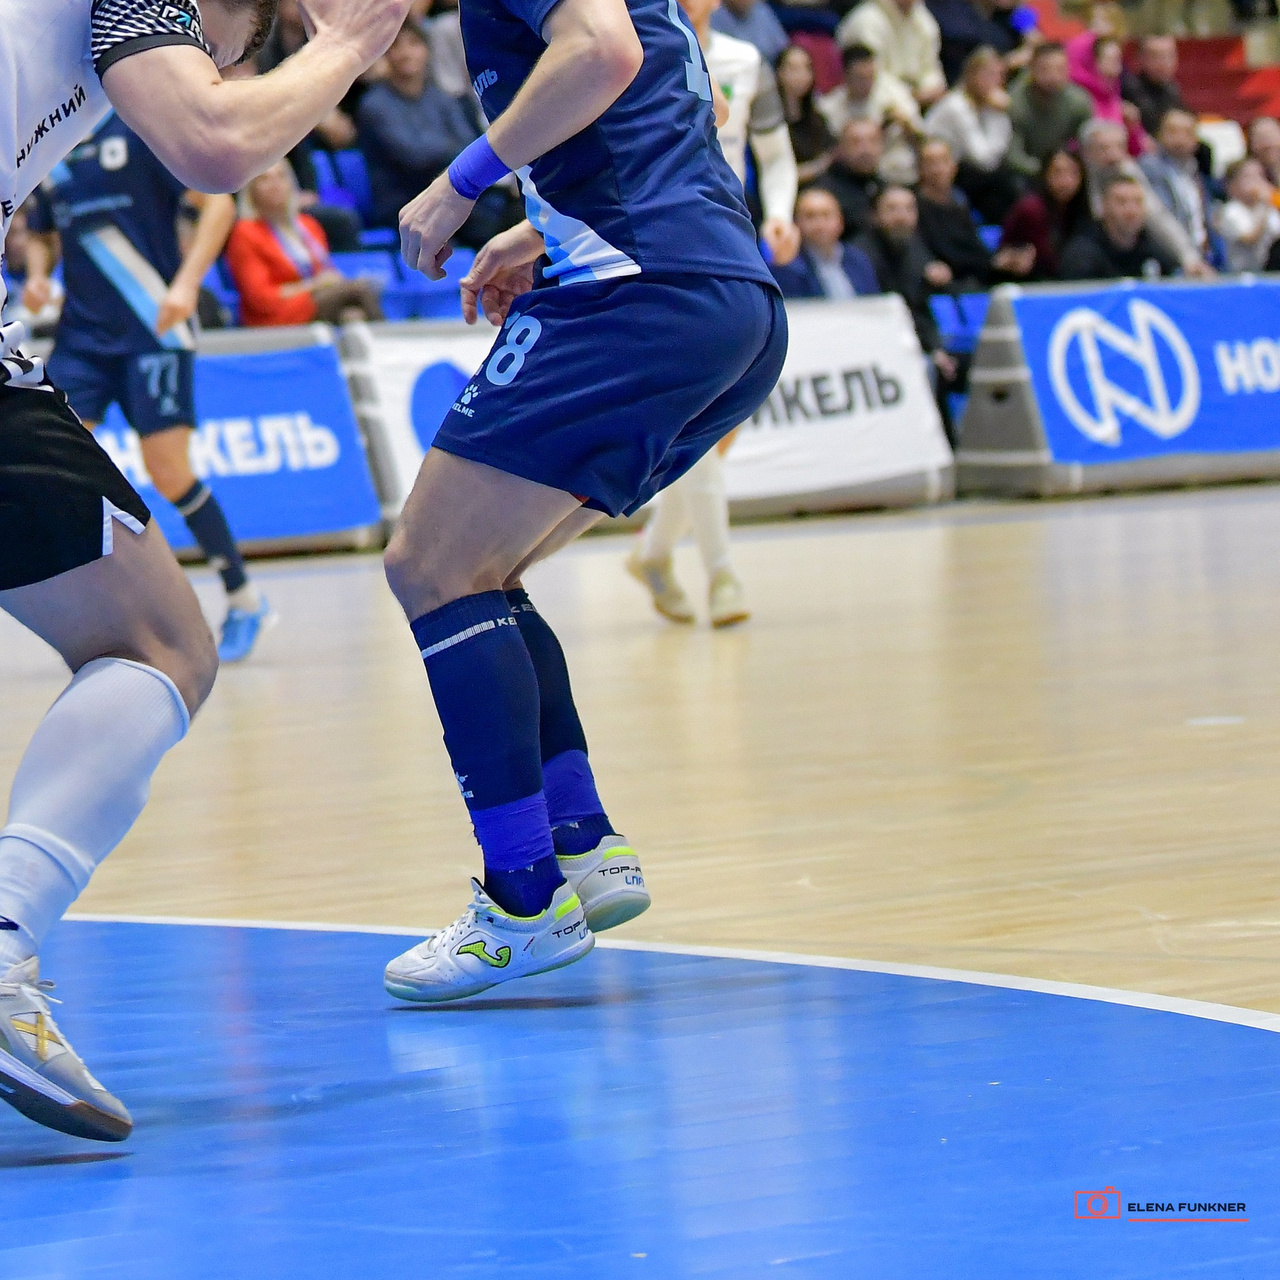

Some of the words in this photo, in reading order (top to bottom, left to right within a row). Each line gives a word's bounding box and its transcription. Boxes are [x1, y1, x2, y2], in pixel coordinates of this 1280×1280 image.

[16, 83, 87, 169] НИЖНИЙ
[138, 351, 179, 400] 77
[484, 312, 542, 386] 8
[1214, 336, 1280, 394] НО
[98, 410, 341, 486] НКЕЛЬ
